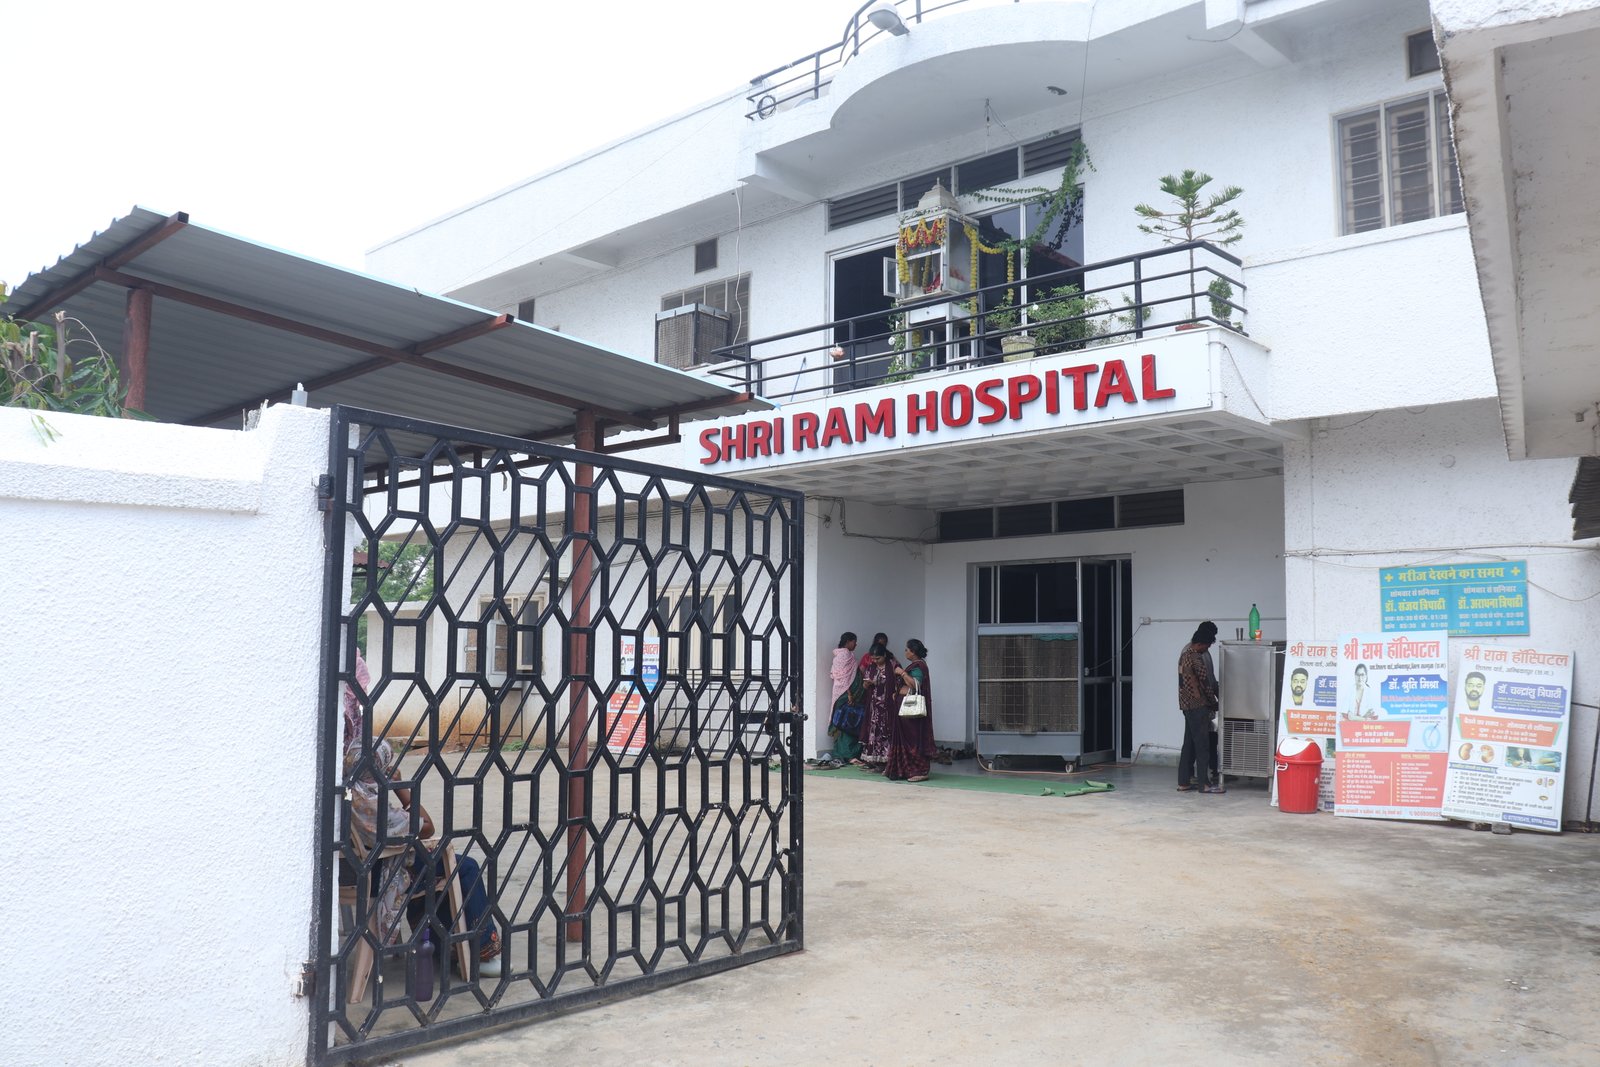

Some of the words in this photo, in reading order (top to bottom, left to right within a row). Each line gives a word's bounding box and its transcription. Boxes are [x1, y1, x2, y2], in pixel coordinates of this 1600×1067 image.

[699, 416, 785, 465] SHRI
[792, 397, 896, 451] RAM
[906, 353, 1177, 434] HOSPITAL
[1398, 569, 1427, 582] मरीज
[1429, 566, 1456, 580] देखने
[1459, 568, 1475, 579] का
[1477, 567, 1504, 579] समय
[1290, 642, 1304, 657] श्री
[1307, 646, 1327, 657] राम
[1343, 637, 1358, 660] श्री
[1362, 642, 1383, 659] राम
[1387, 636, 1440, 659] हॉस्पिटल
[1464, 645, 1480, 661] श्री
[1484, 649, 1508, 663] राम
[1512, 648, 1569, 667] हॉस्पिटल
[1388, 678, 1400, 690] डॉ.
[1402, 677, 1418, 693] श्रुति
[1420, 676, 1439, 690] मिश्रा
[1498, 683, 1508, 695] डॉ.
[1537, 686, 1562, 699] त्रिपाठी
